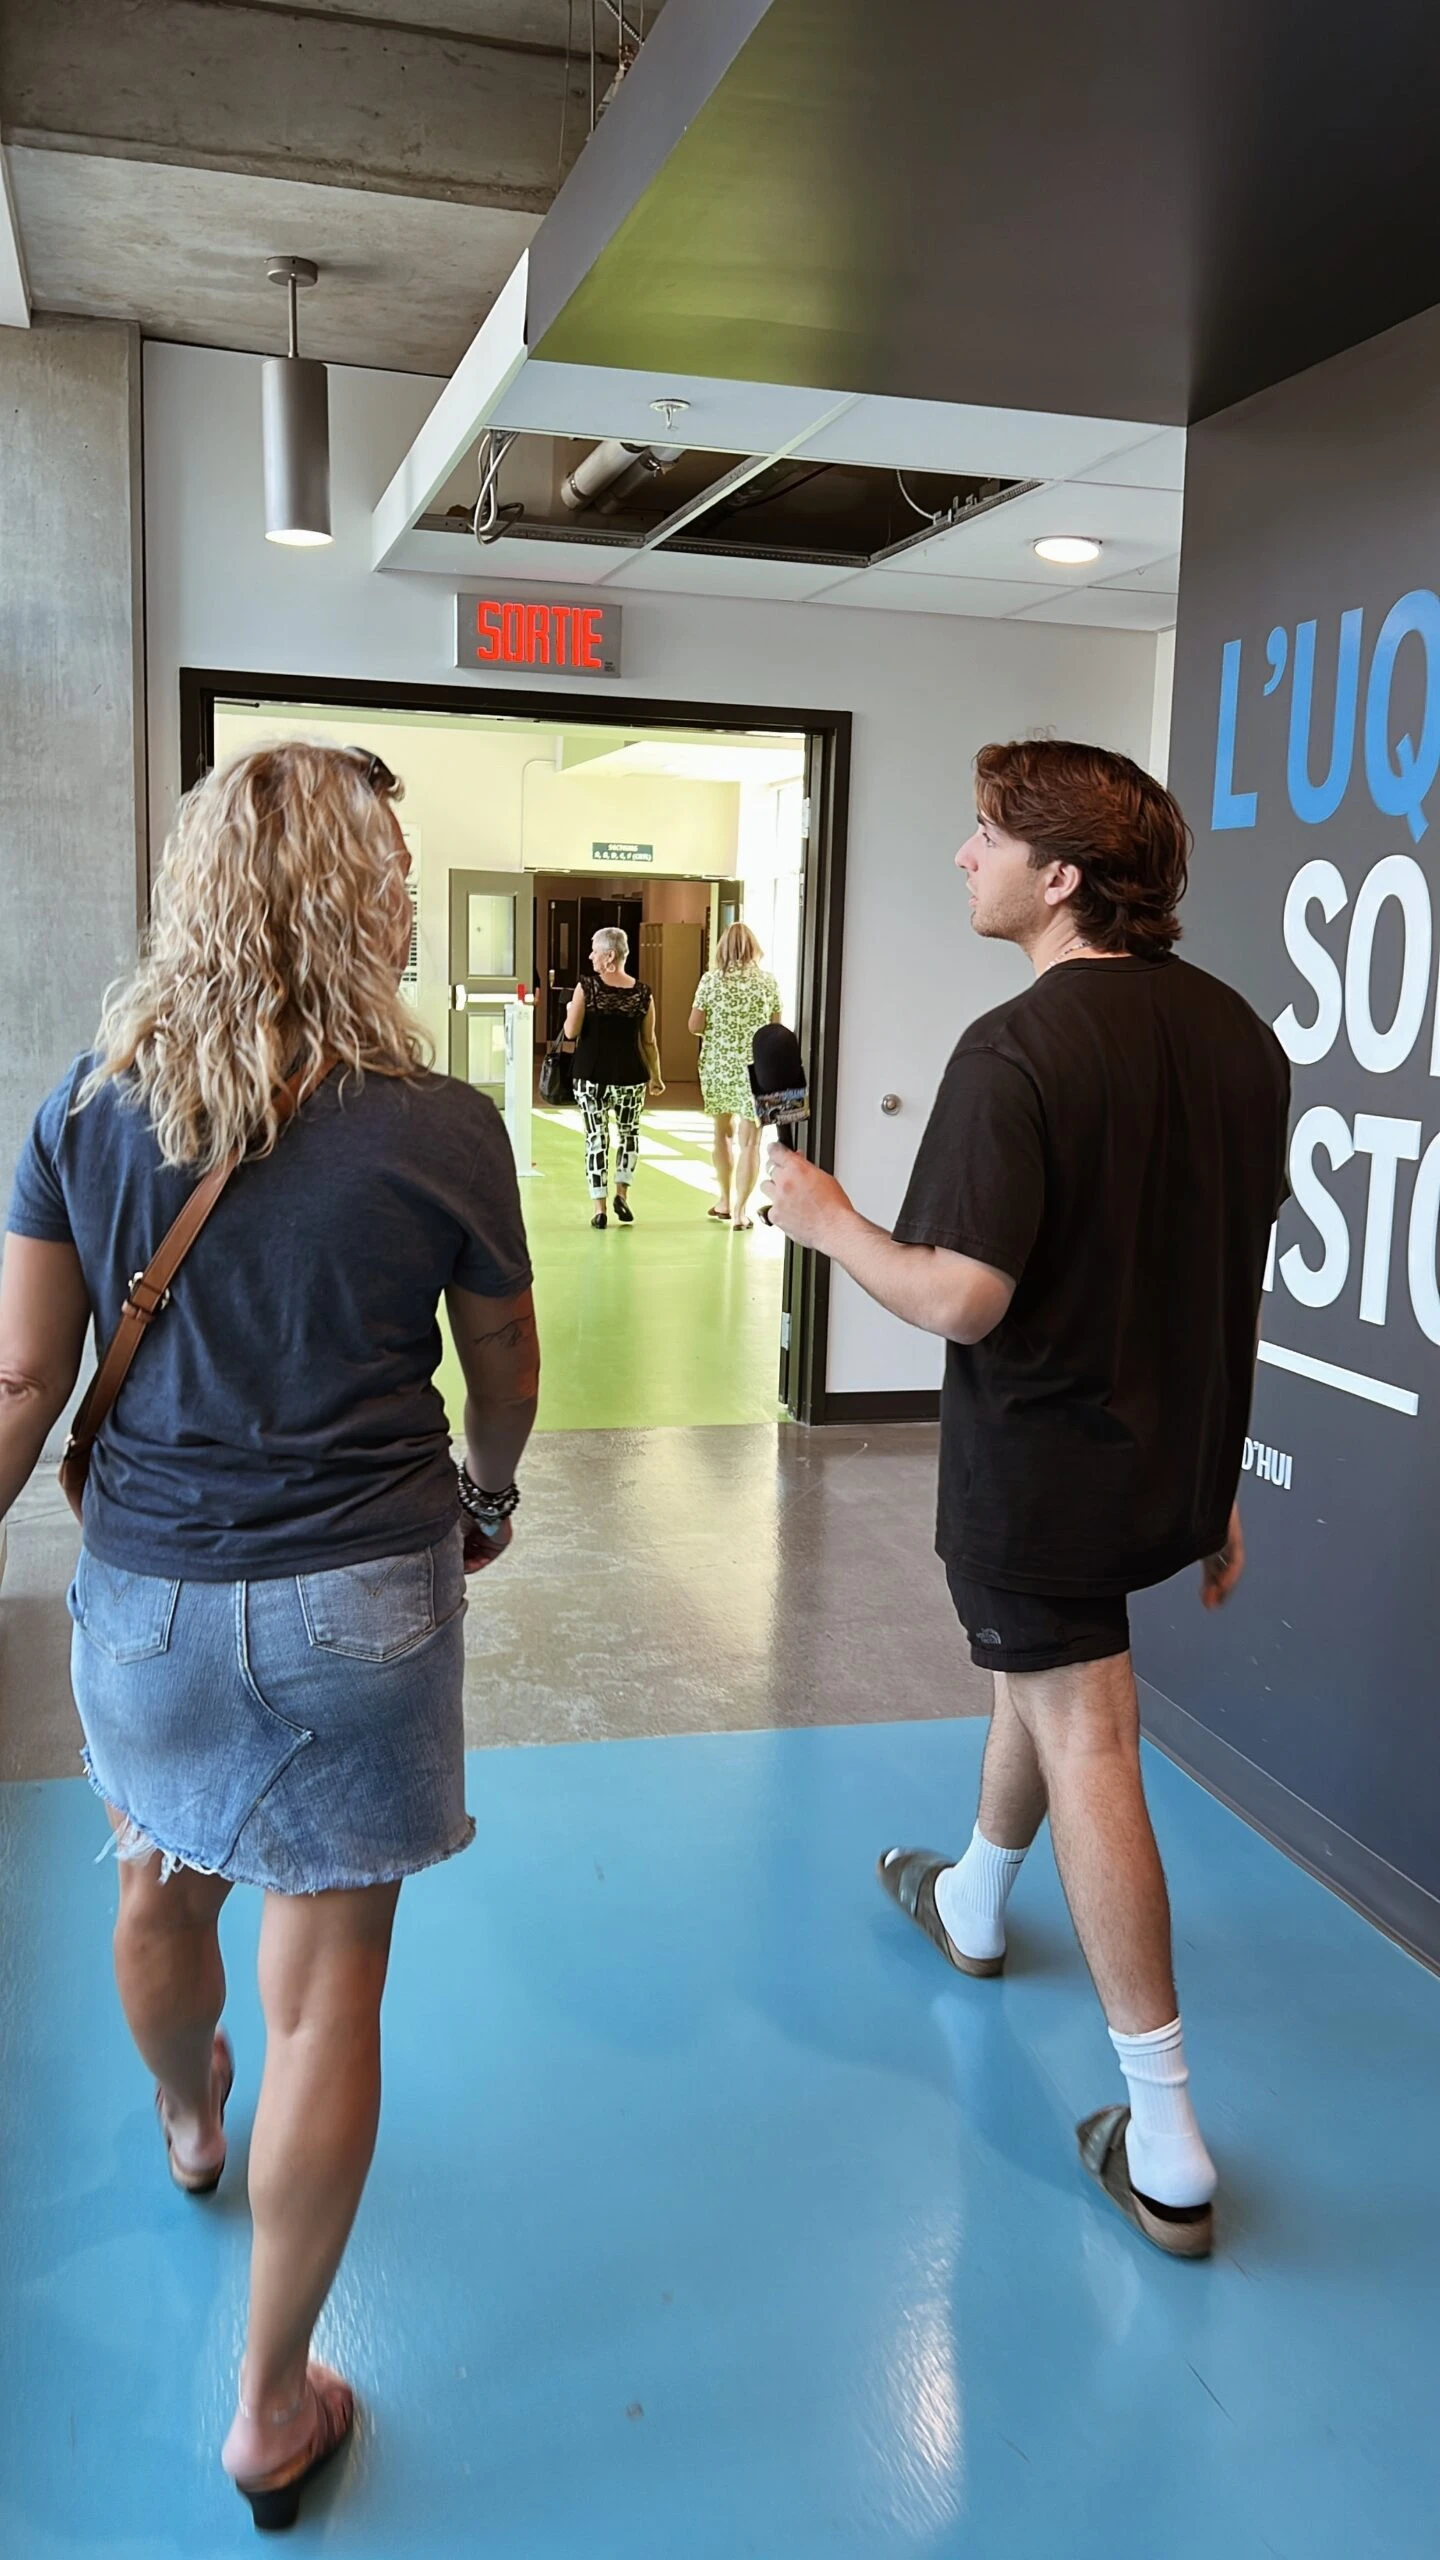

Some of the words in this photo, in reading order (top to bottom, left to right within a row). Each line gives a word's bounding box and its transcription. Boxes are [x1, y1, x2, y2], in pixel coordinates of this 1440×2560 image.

[476, 600, 603, 669] SORTIE
[1210, 588, 1440, 844] L'UQ
[1272, 854, 1440, 1077] SO
[1262, 1105, 1440, 1347] ST
